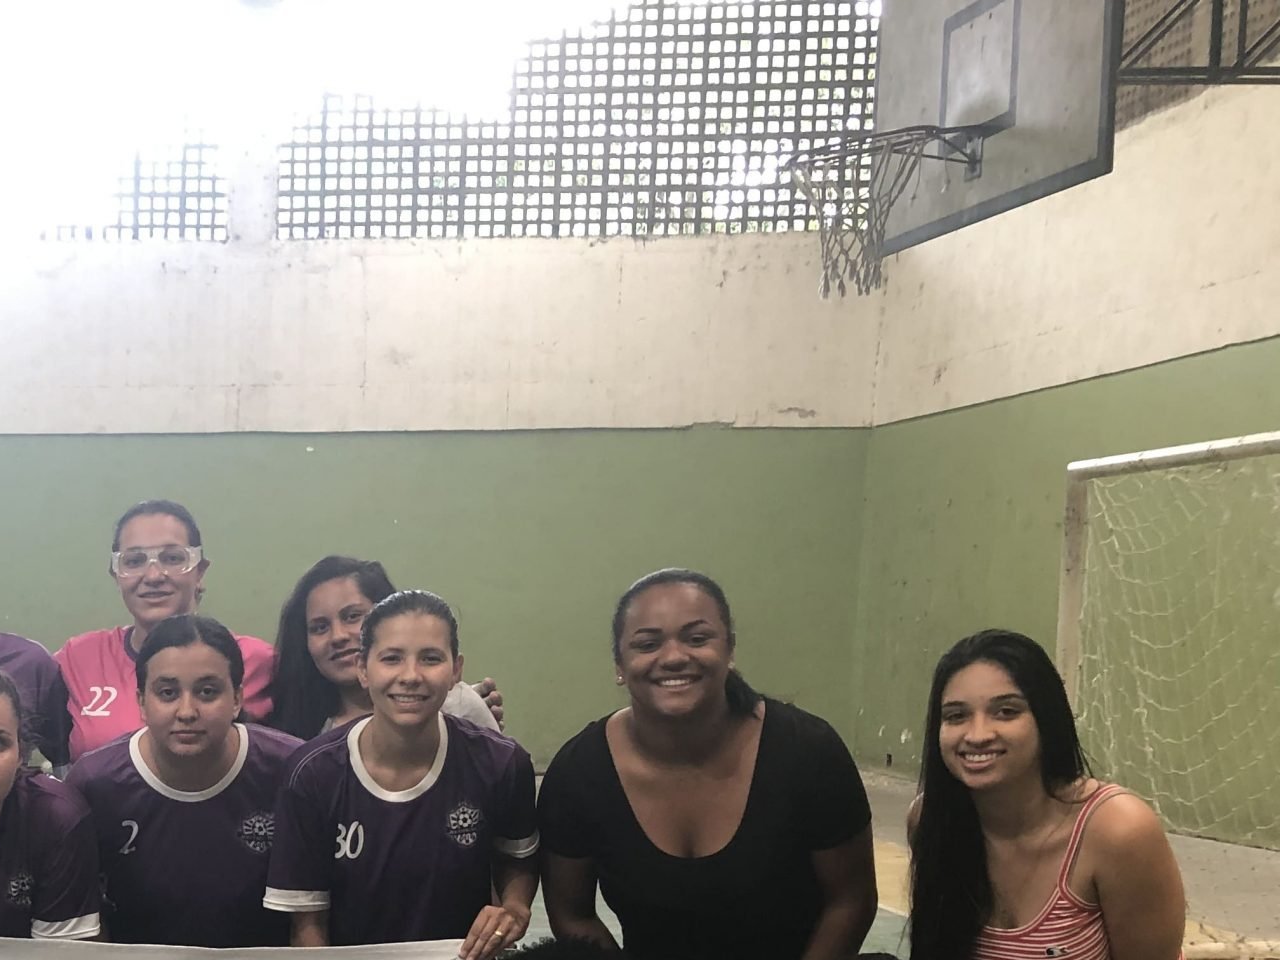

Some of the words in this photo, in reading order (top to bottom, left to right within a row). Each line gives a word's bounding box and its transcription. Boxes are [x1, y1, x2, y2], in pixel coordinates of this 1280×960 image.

[81, 686, 118, 716] 22
[119, 820, 139, 854] 2
[334, 821, 365, 859] 30
